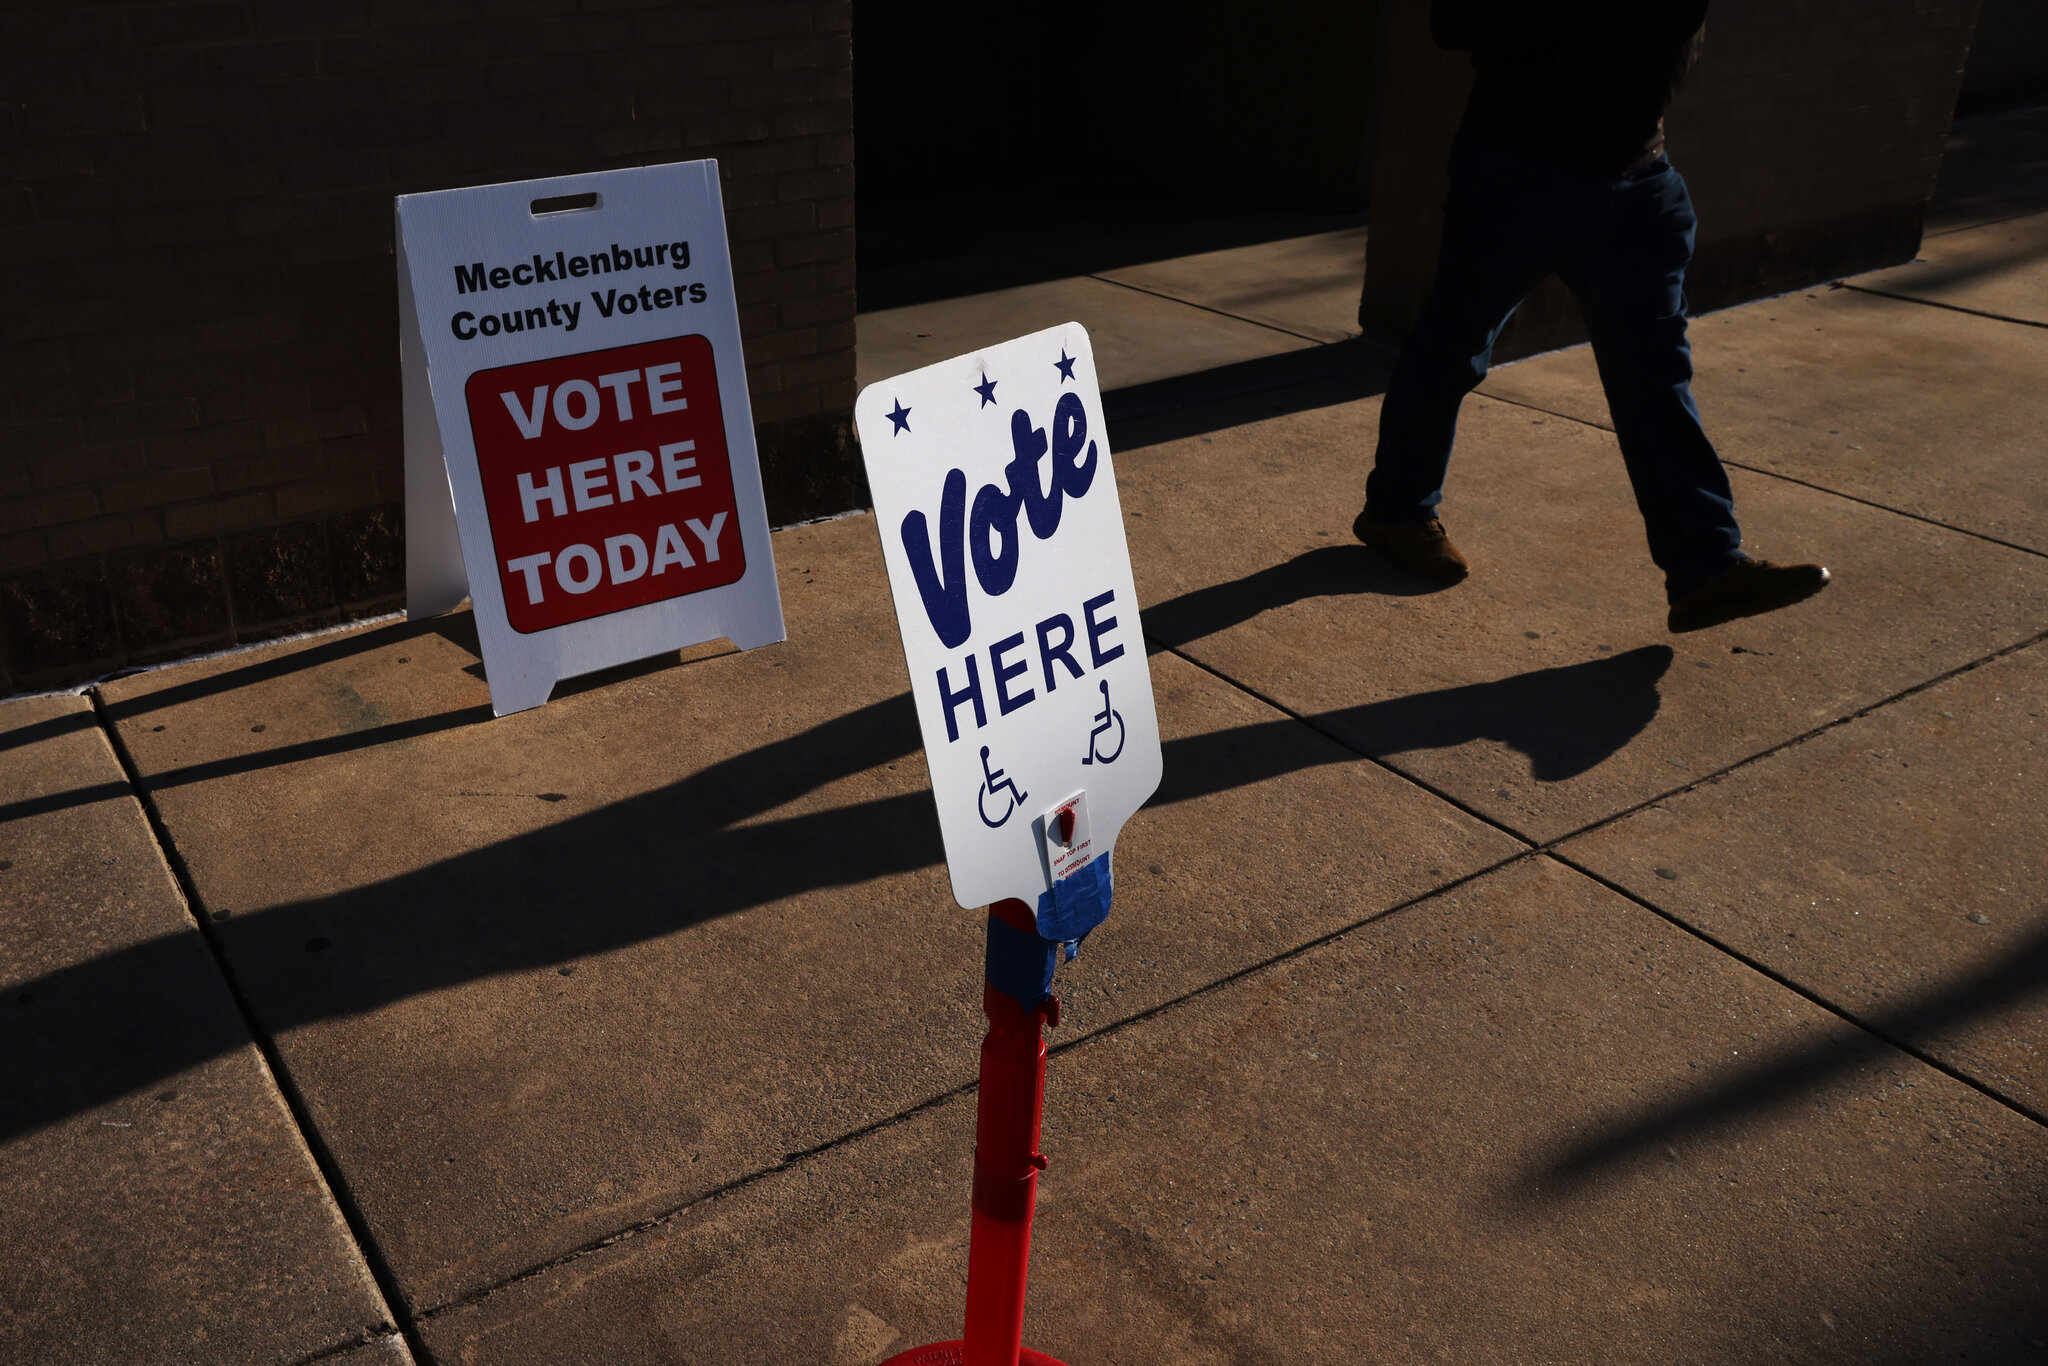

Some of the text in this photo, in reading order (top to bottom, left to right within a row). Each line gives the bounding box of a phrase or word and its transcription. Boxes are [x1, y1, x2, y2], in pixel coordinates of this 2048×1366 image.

[454, 240, 691, 294] Mecklenburg
[451, 281, 707, 340] County Voters
[499, 361, 689, 441] VOTE
[516, 439, 703, 524] HERE
[900, 392, 1097, 649] Vote
[507, 511, 729, 606] TODAY
[935, 589, 1125, 743] HERE
[1054, 840, 1091, 866] SNAP TOP FIRST
[1065, 854, 1090, 873] DISMOUNT
